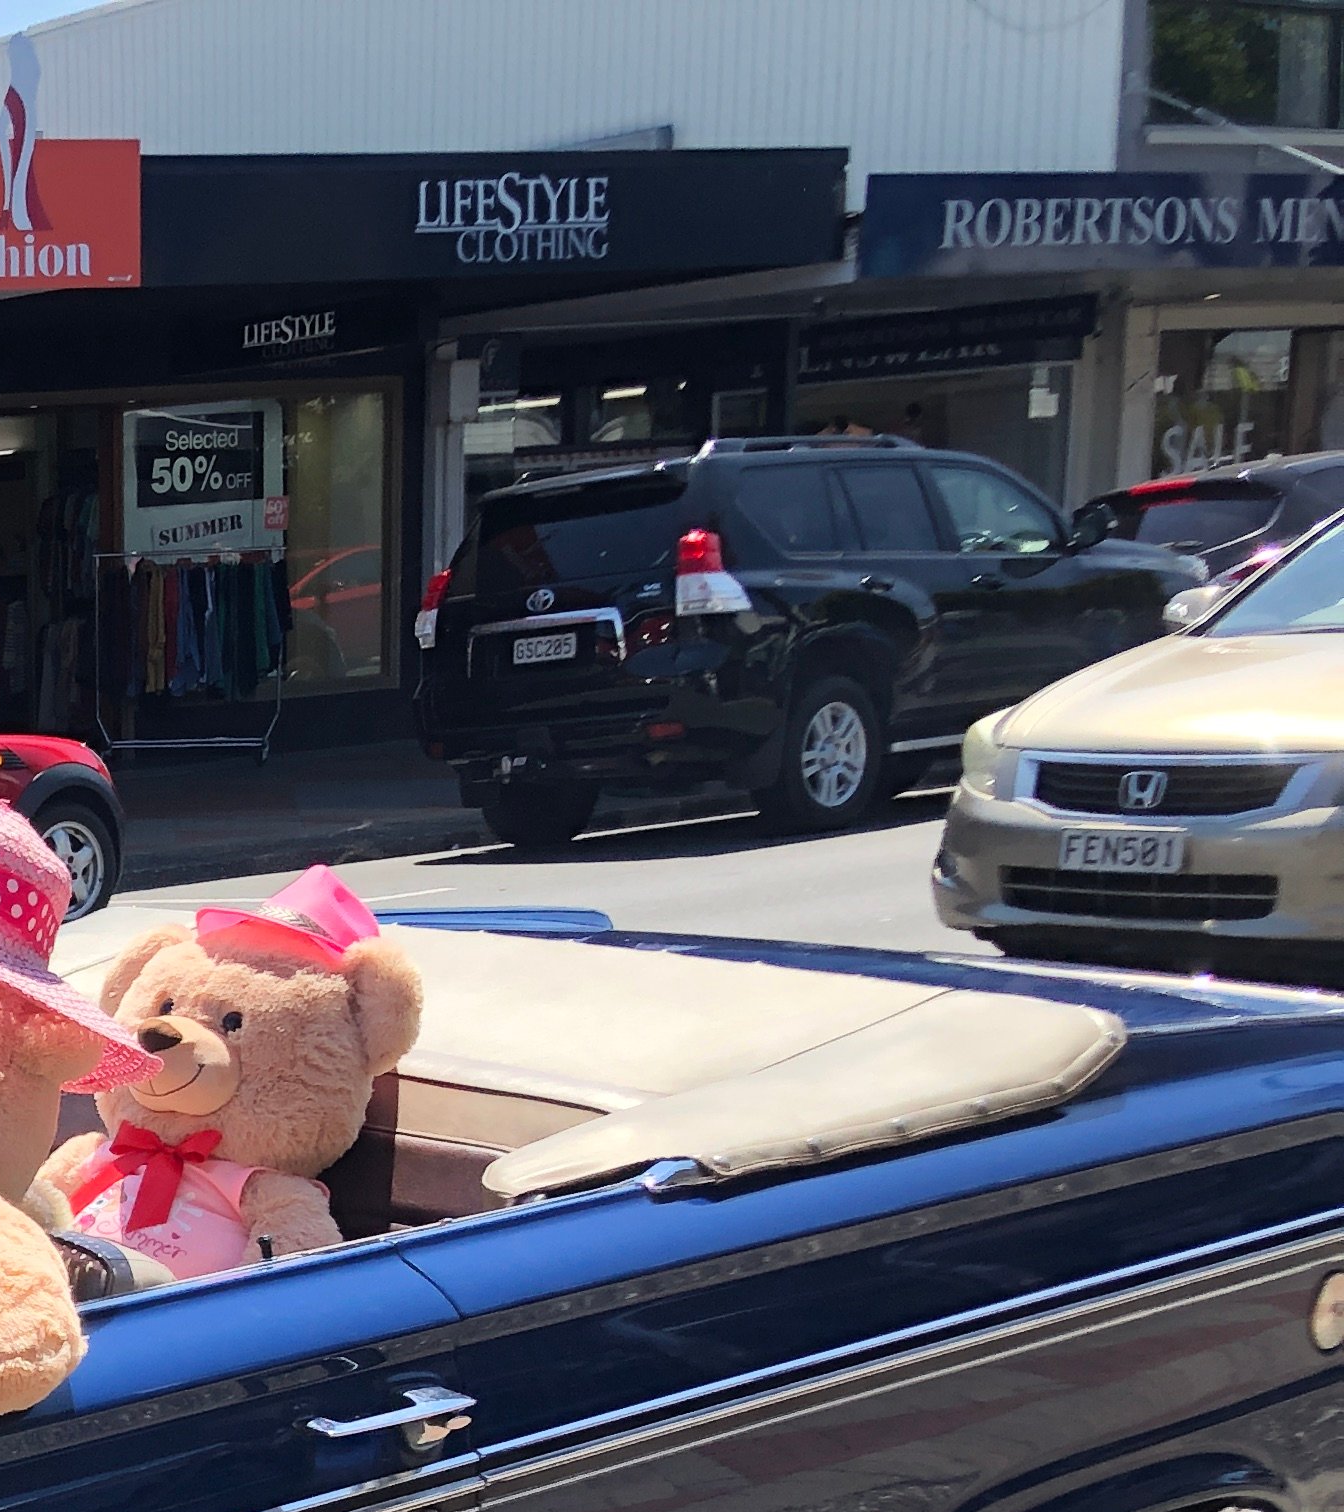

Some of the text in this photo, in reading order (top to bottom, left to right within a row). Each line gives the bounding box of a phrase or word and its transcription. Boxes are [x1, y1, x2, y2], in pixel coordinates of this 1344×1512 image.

[938, 196, 1240, 250] ROBERTSONS
[456, 227, 610, 263] CLOTHING
[165, 427, 239, 451] Selected
[1160, 422, 1255, 477] SALE
[151, 454, 253, 494] 50% OFF
[159, 514, 243, 546] SUMMER
[1063, 832, 1176, 868] FEN501
